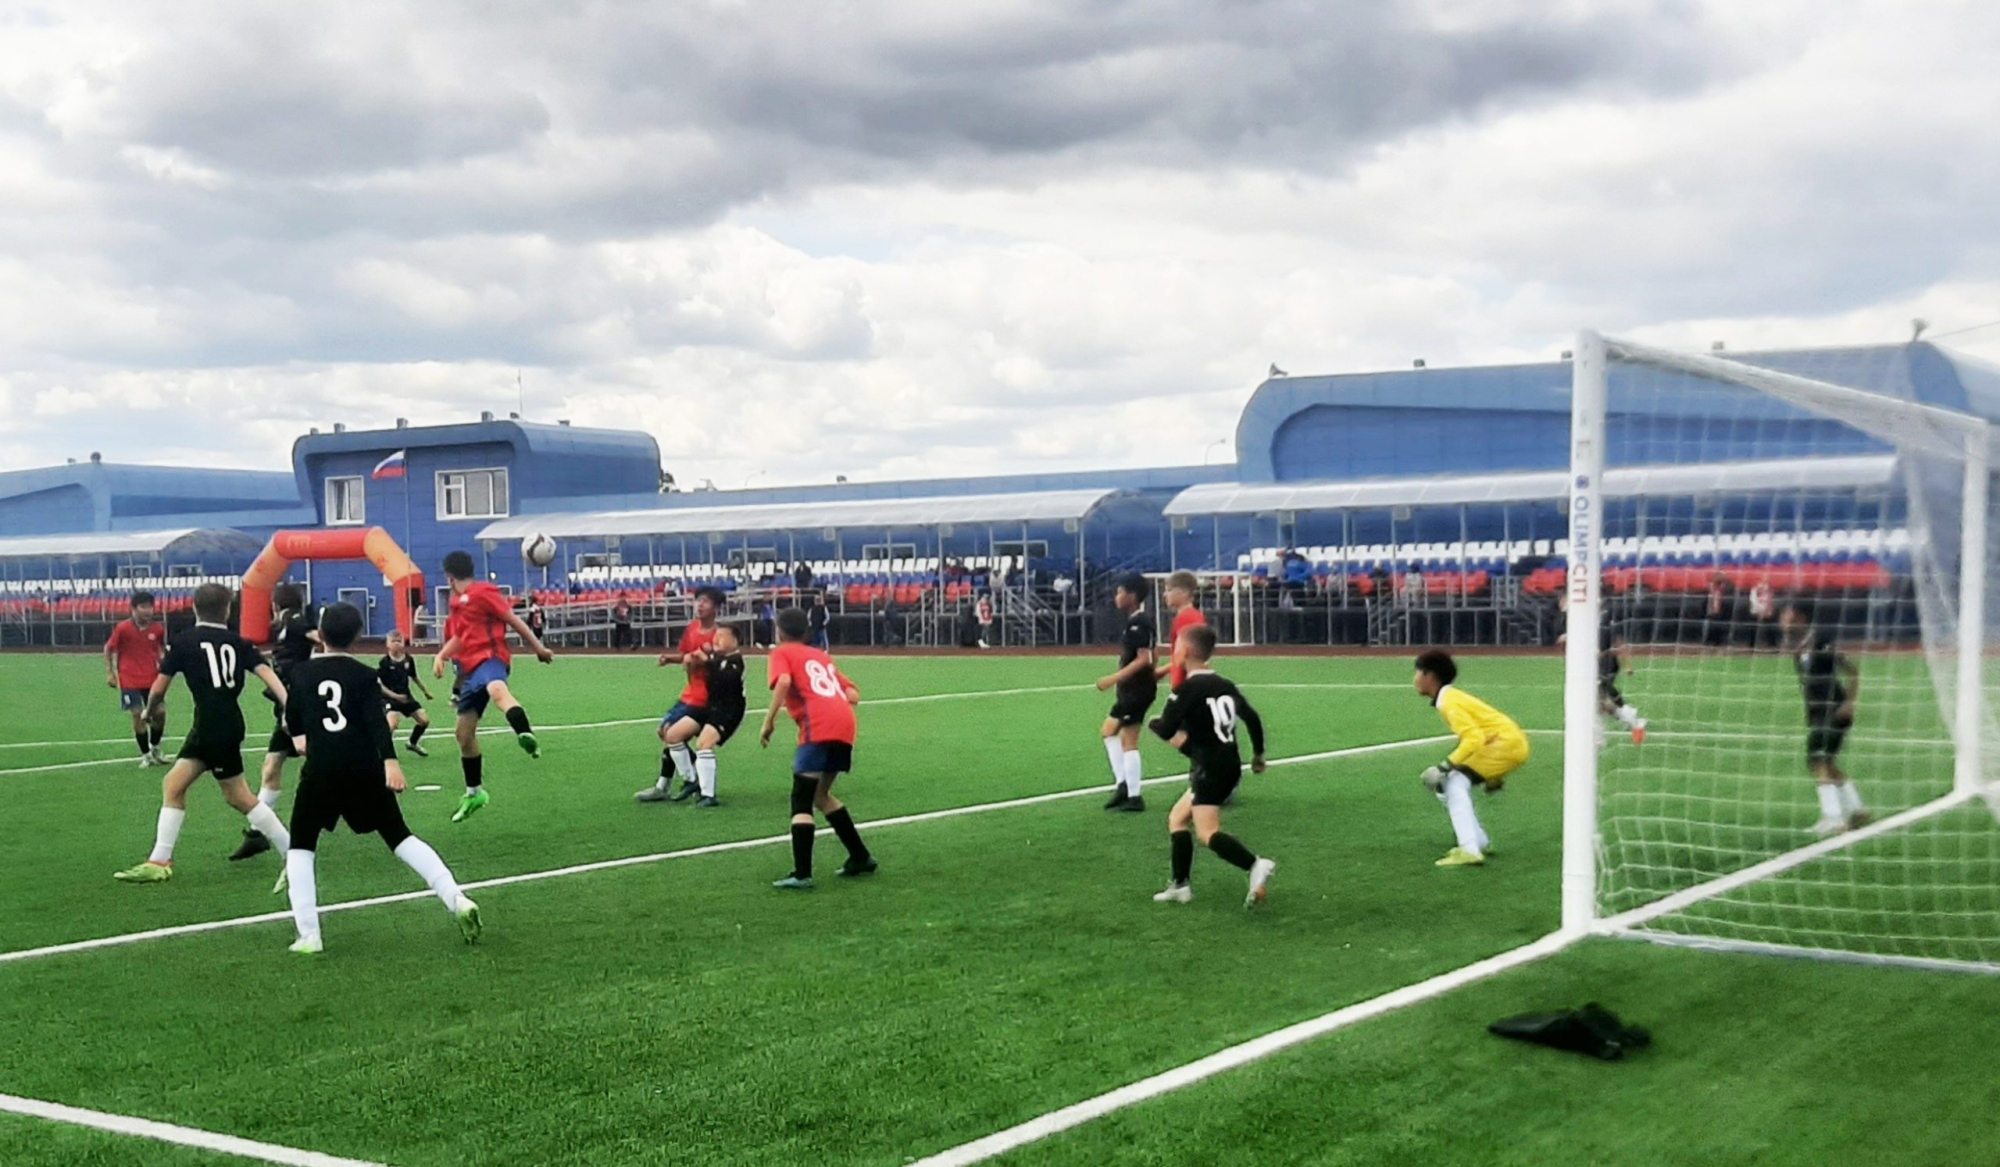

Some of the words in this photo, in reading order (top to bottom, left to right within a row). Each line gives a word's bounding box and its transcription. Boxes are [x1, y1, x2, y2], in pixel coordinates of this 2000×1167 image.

[200, 641, 236, 689] 10
[317, 679, 348, 732] 3
[1206, 695, 1236, 744] 19
